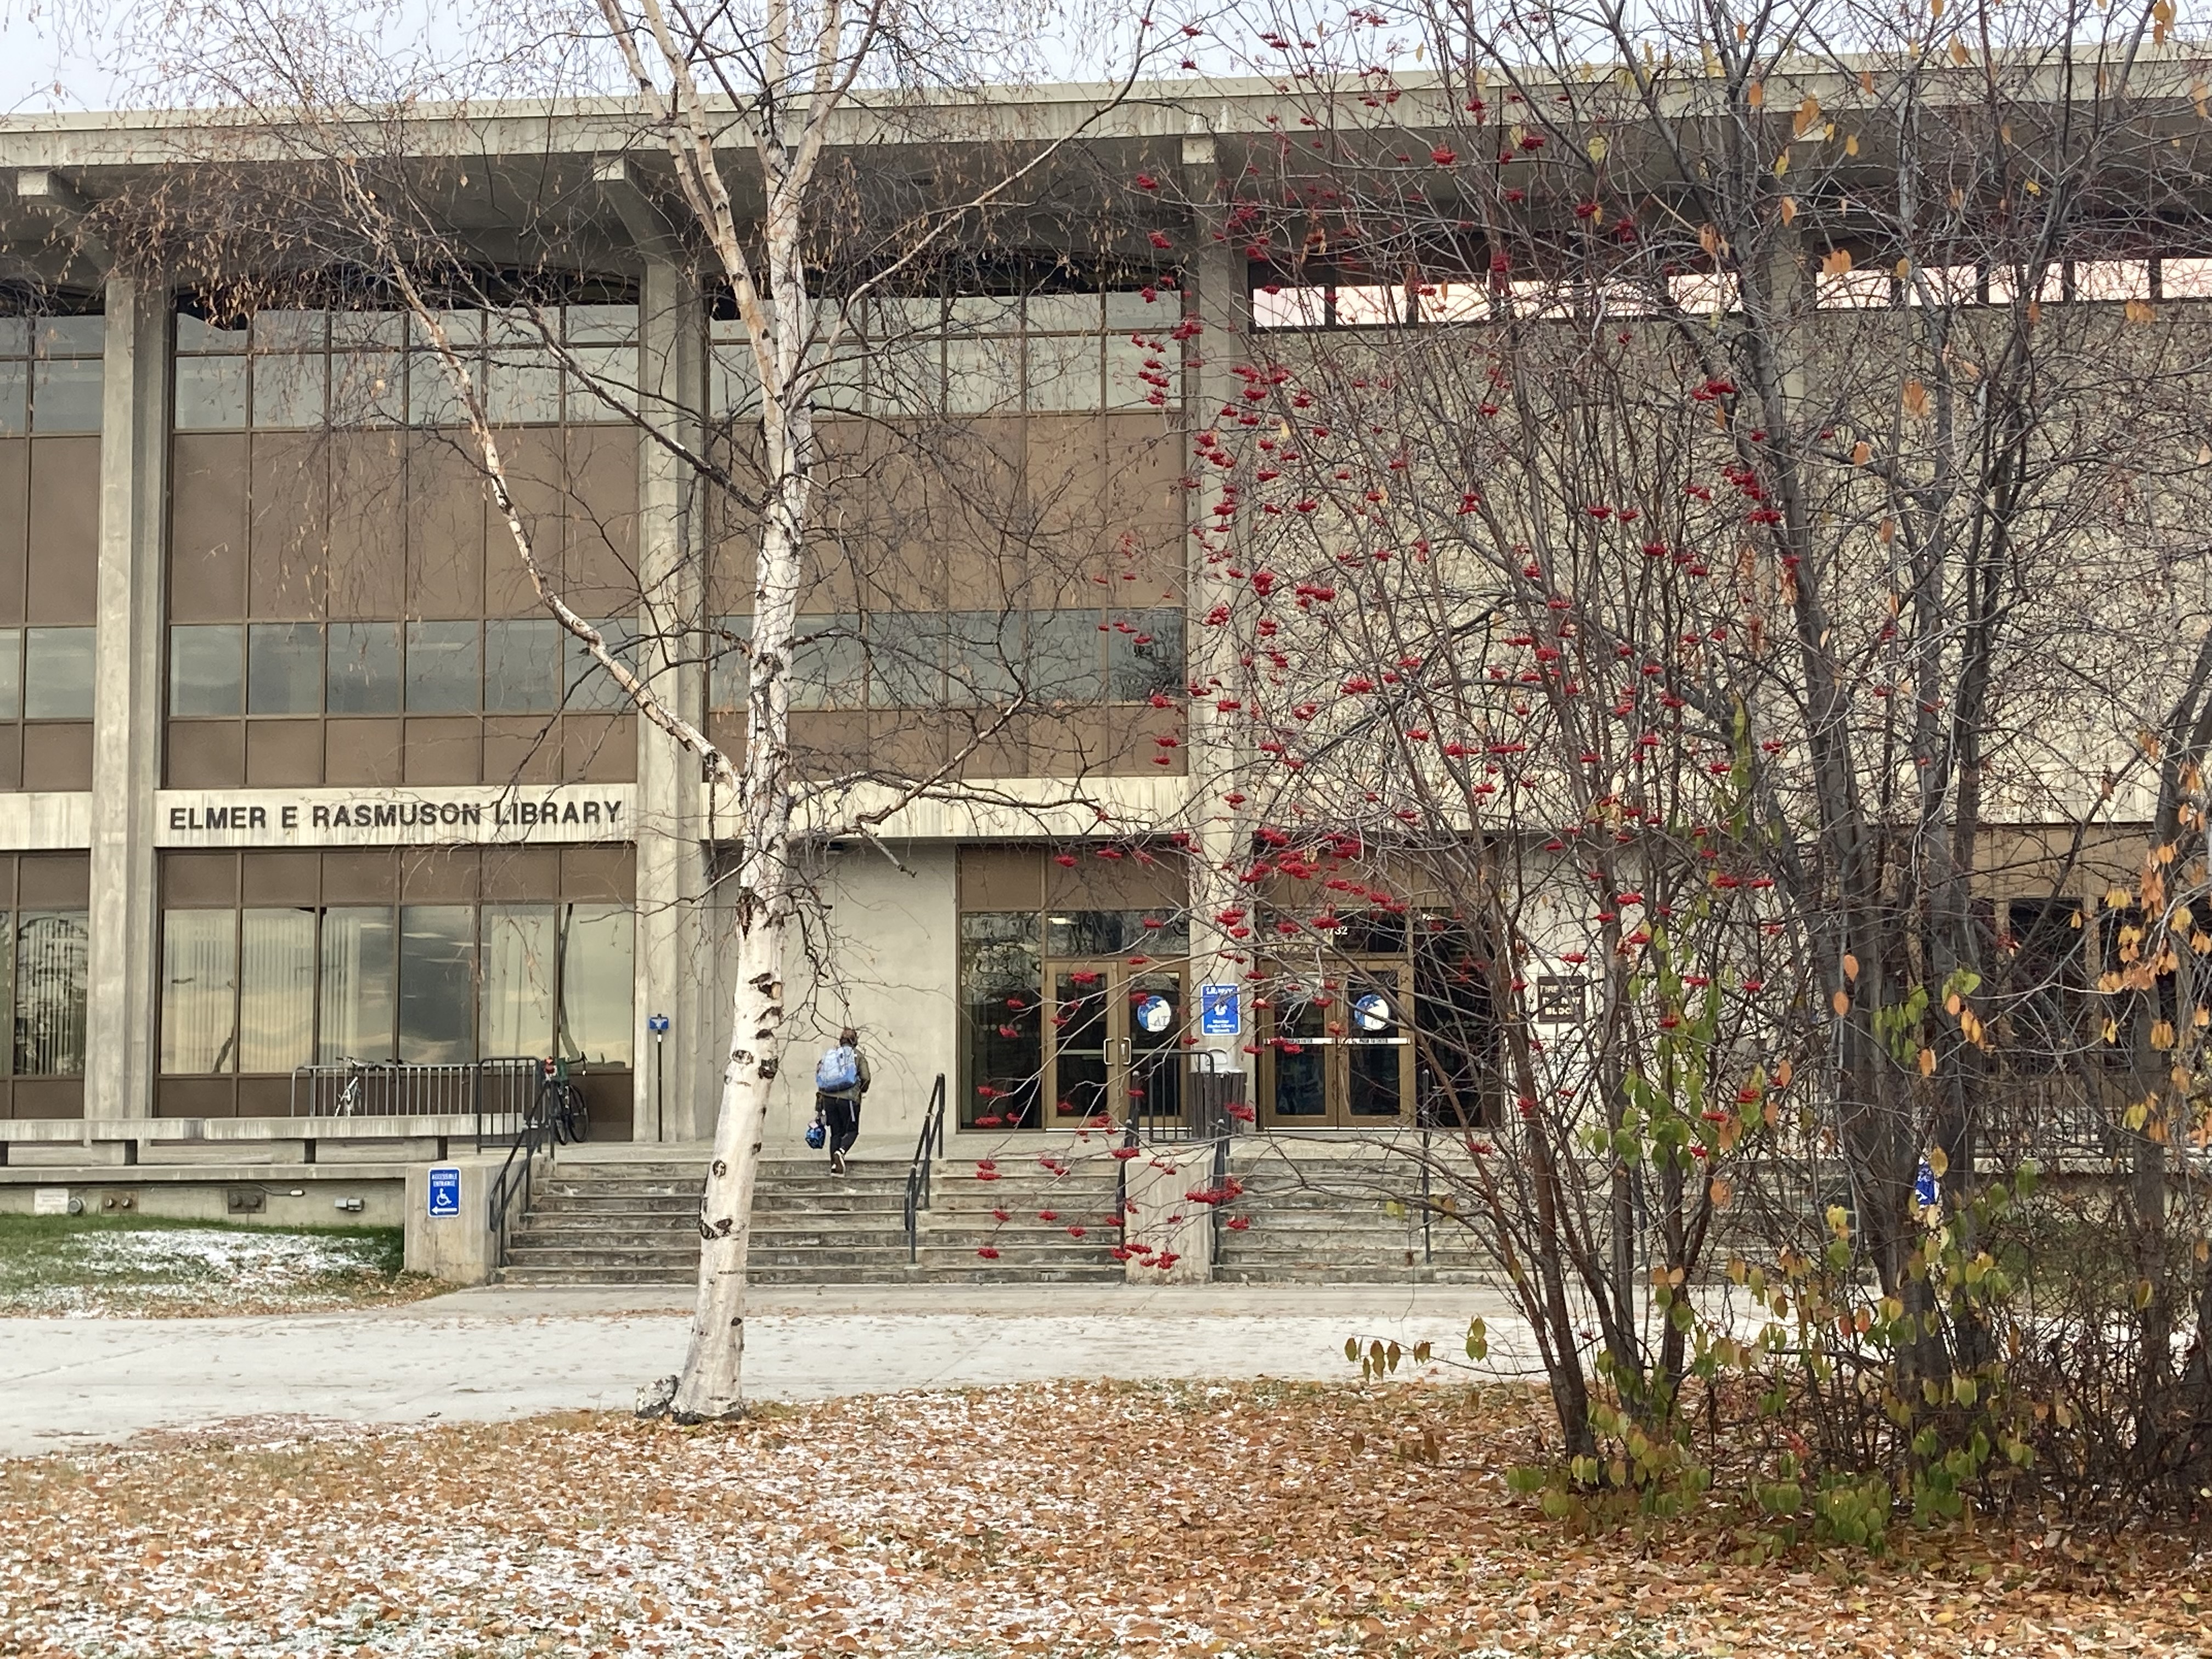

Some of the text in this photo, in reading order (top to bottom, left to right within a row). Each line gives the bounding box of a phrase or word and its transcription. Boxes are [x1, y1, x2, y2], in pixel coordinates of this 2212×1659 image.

[170, 800, 622, 830] ELMER E RASMUSON LIBRARY
[1545, 1007, 1573, 1015] BLOC
